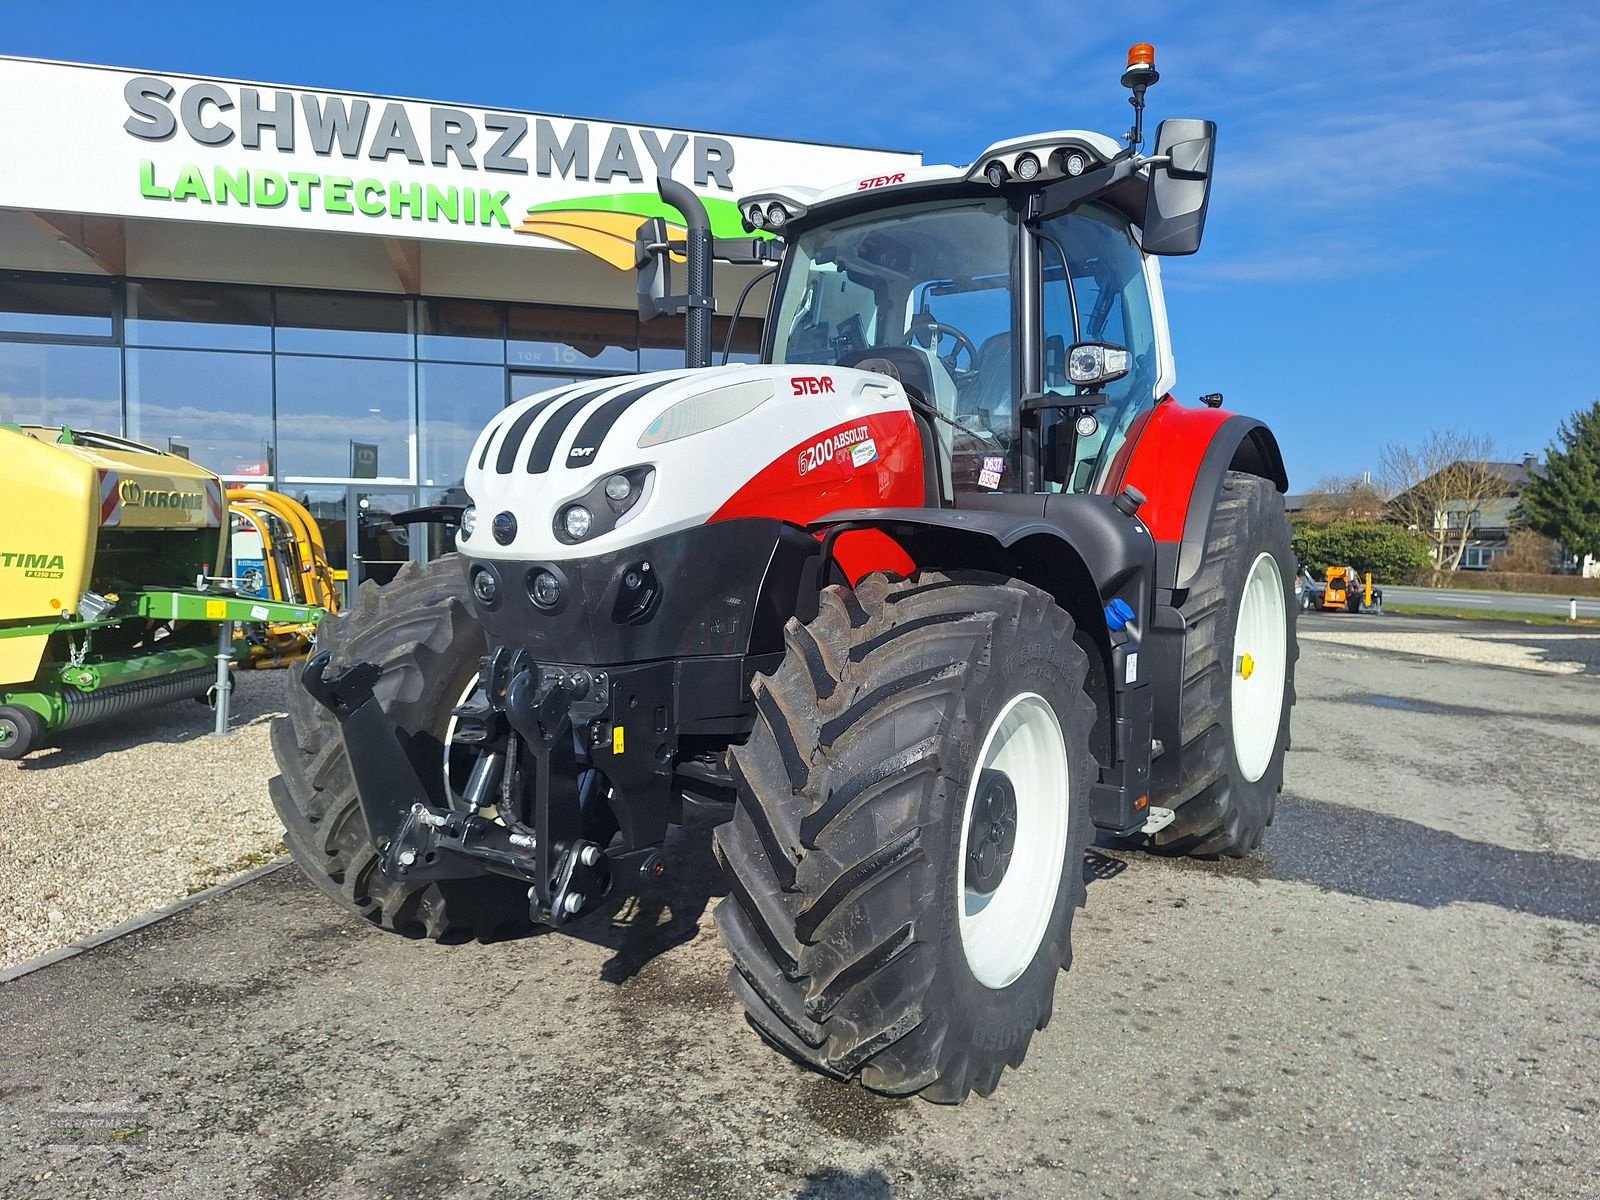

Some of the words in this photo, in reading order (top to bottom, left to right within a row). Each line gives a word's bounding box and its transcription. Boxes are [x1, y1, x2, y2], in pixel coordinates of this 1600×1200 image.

[123, 76, 735, 192] SCHWARZMAYR
[857, 173, 906, 190] STEYR
[139, 158, 511, 229] LANDTECHNIK
[518, 351, 542, 361] TOR
[551, 345, 577, 364] 16
[790, 376, 836, 396] STEYR
[833, 425, 869, 451] ABSOLUT
[569, 447, 595, 457] CVT
[984, 457, 1002, 472] 0637
[142, 489, 204, 510] KRONE
[0, 552, 65, 570] TIMA
